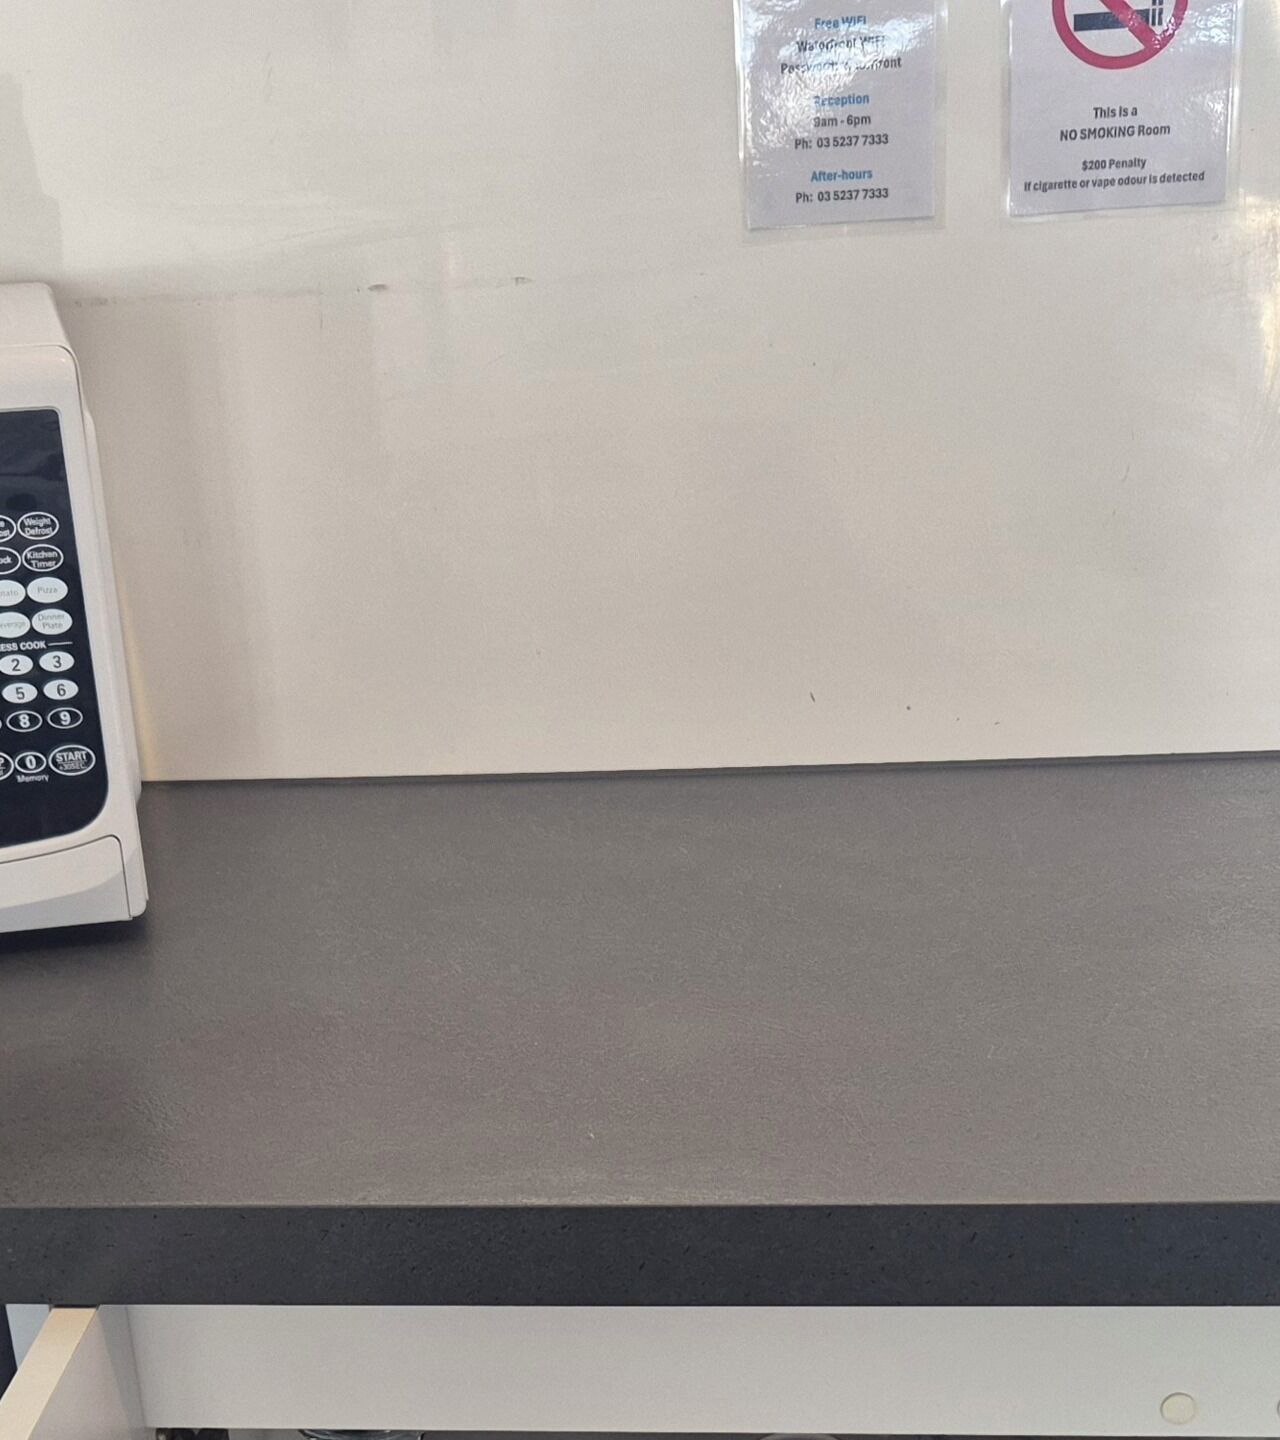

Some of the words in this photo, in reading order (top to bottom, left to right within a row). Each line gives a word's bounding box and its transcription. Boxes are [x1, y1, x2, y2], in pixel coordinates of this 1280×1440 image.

[814, 17, 839, 30] Free
[813, 93, 870, 107] Reception
[1093, 106, 1116, 119] This
[1131, 107, 1138, 117] a
[813, 116, 838, 128] 9am
[846, 114, 871, 128] 6pm
[1060, 129, 1078, 141] NO
[1080, 126, 1135, 140] SMOKING
[1137, 125, 1171, 137] Room
[794, 137, 812, 150] Ph:
[816, 137, 830, 148] 03
[832, 135, 859, 147] 5237
[861, 133, 889, 146] 7333
[1082, 159, 1107, 172] $200
[1108, 157, 1147, 170] Penalty
[810, 169, 873, 183] After-hours
[1024, 181, 1032, 192] If
[1033, 179, 1078, 193] cigarette
[1079, 179, 1091, 189] or
[1092, 177, 1115, 190] vape
[1117, 174, 1147, 186] odour
[1159, 171, 1205, 183] detected
[795, 191, 813, 204] Ph:
[817, 190, 831, 202] 03
[833, 189, 860, 201] 5237
[861, 187, 889, 200] 7333
[23, 517, 52, 527] Weight
[24, 527, 53, 536] Defrost
[26, 551, 58, 560] Kitchen
[30, 559, 56, 568] Timer
[37, 586, 58, 594] Pizza
[37, 613, 65, 621] Dinner
[42, 621, 63, 629] Plate
[20, 640, 47, 651] COOK
[11, 658, 21, 672] 2
[52, 655, 62, 668] 3
[15, 686, 25, 700] 5
[56, 683, 66, 697] 6
[19, 713, 30, 728] 8
[60, 711, 71, 725] 9
[25, 755, 36, 769] 0
[55, 750, 87, 762] START
[16, 774, 49, 783] Memory
